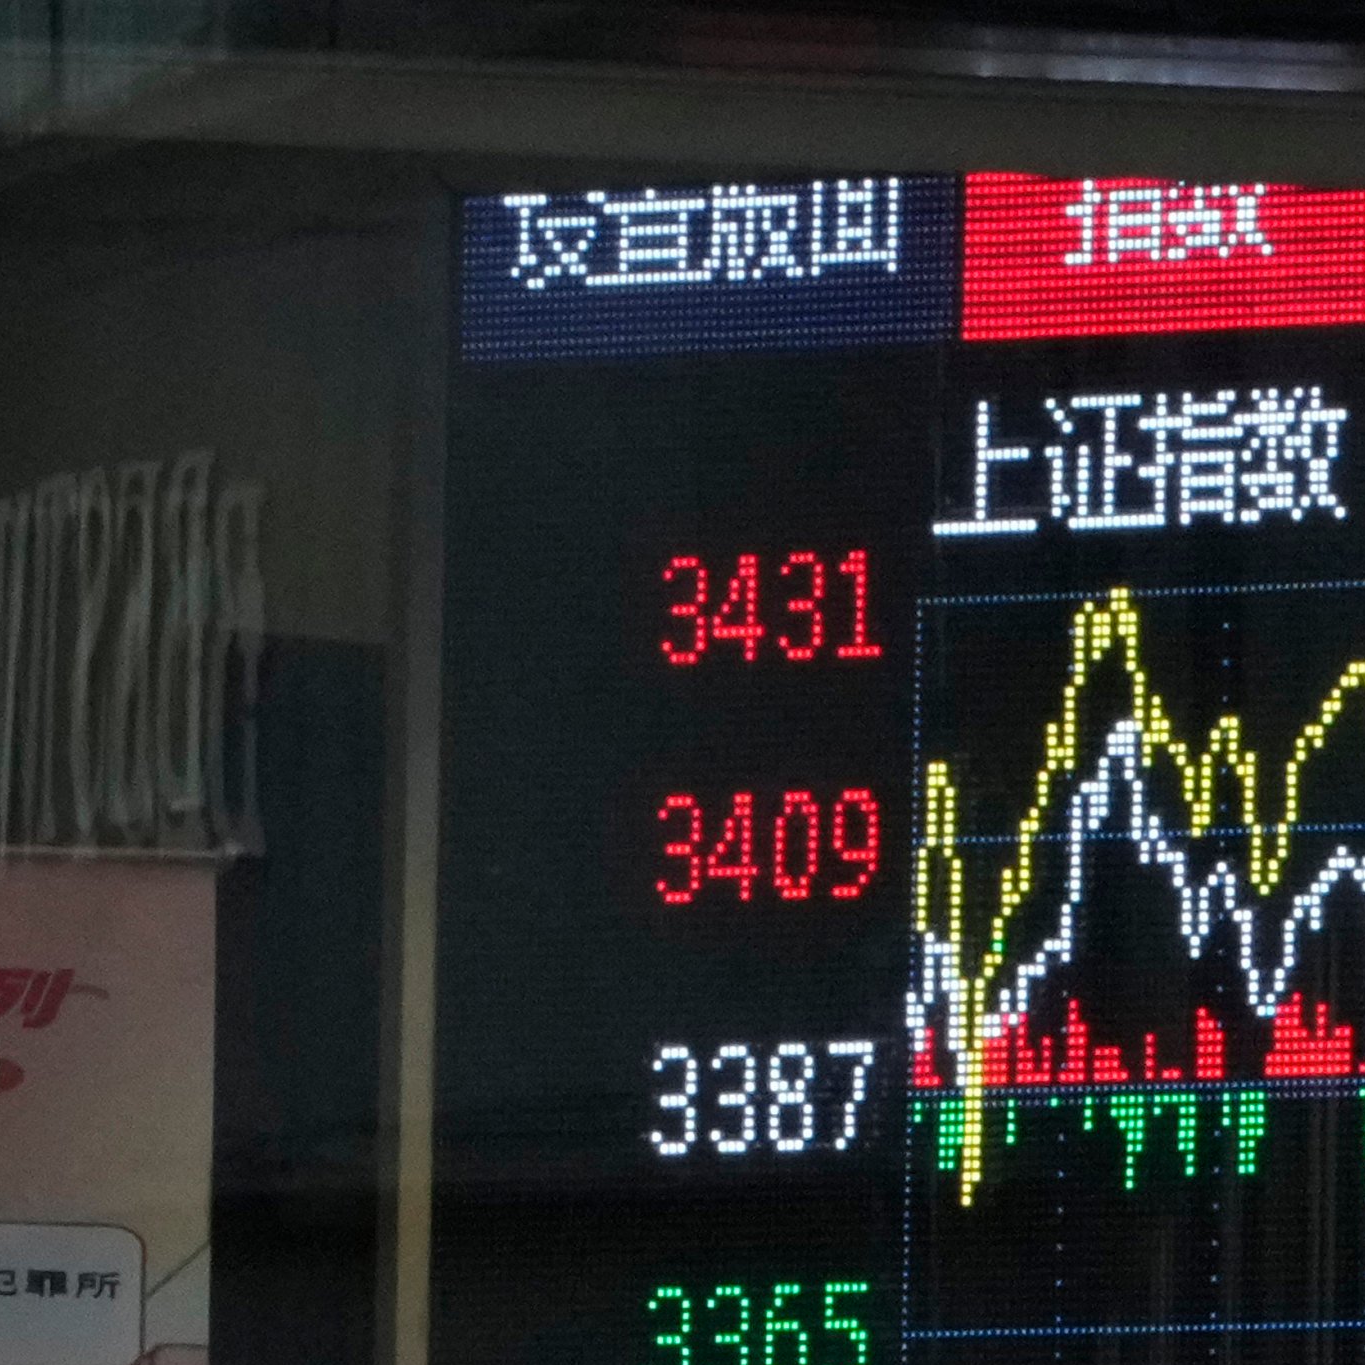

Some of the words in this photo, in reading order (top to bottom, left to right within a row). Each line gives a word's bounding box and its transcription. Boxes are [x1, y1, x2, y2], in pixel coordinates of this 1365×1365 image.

[933, 388, 1348, 536] 上证指数
[663, 550, 882, 664] 3431
[657, 788, 881, 905] 3409
[651, 1040, 875, 1155] 3387
